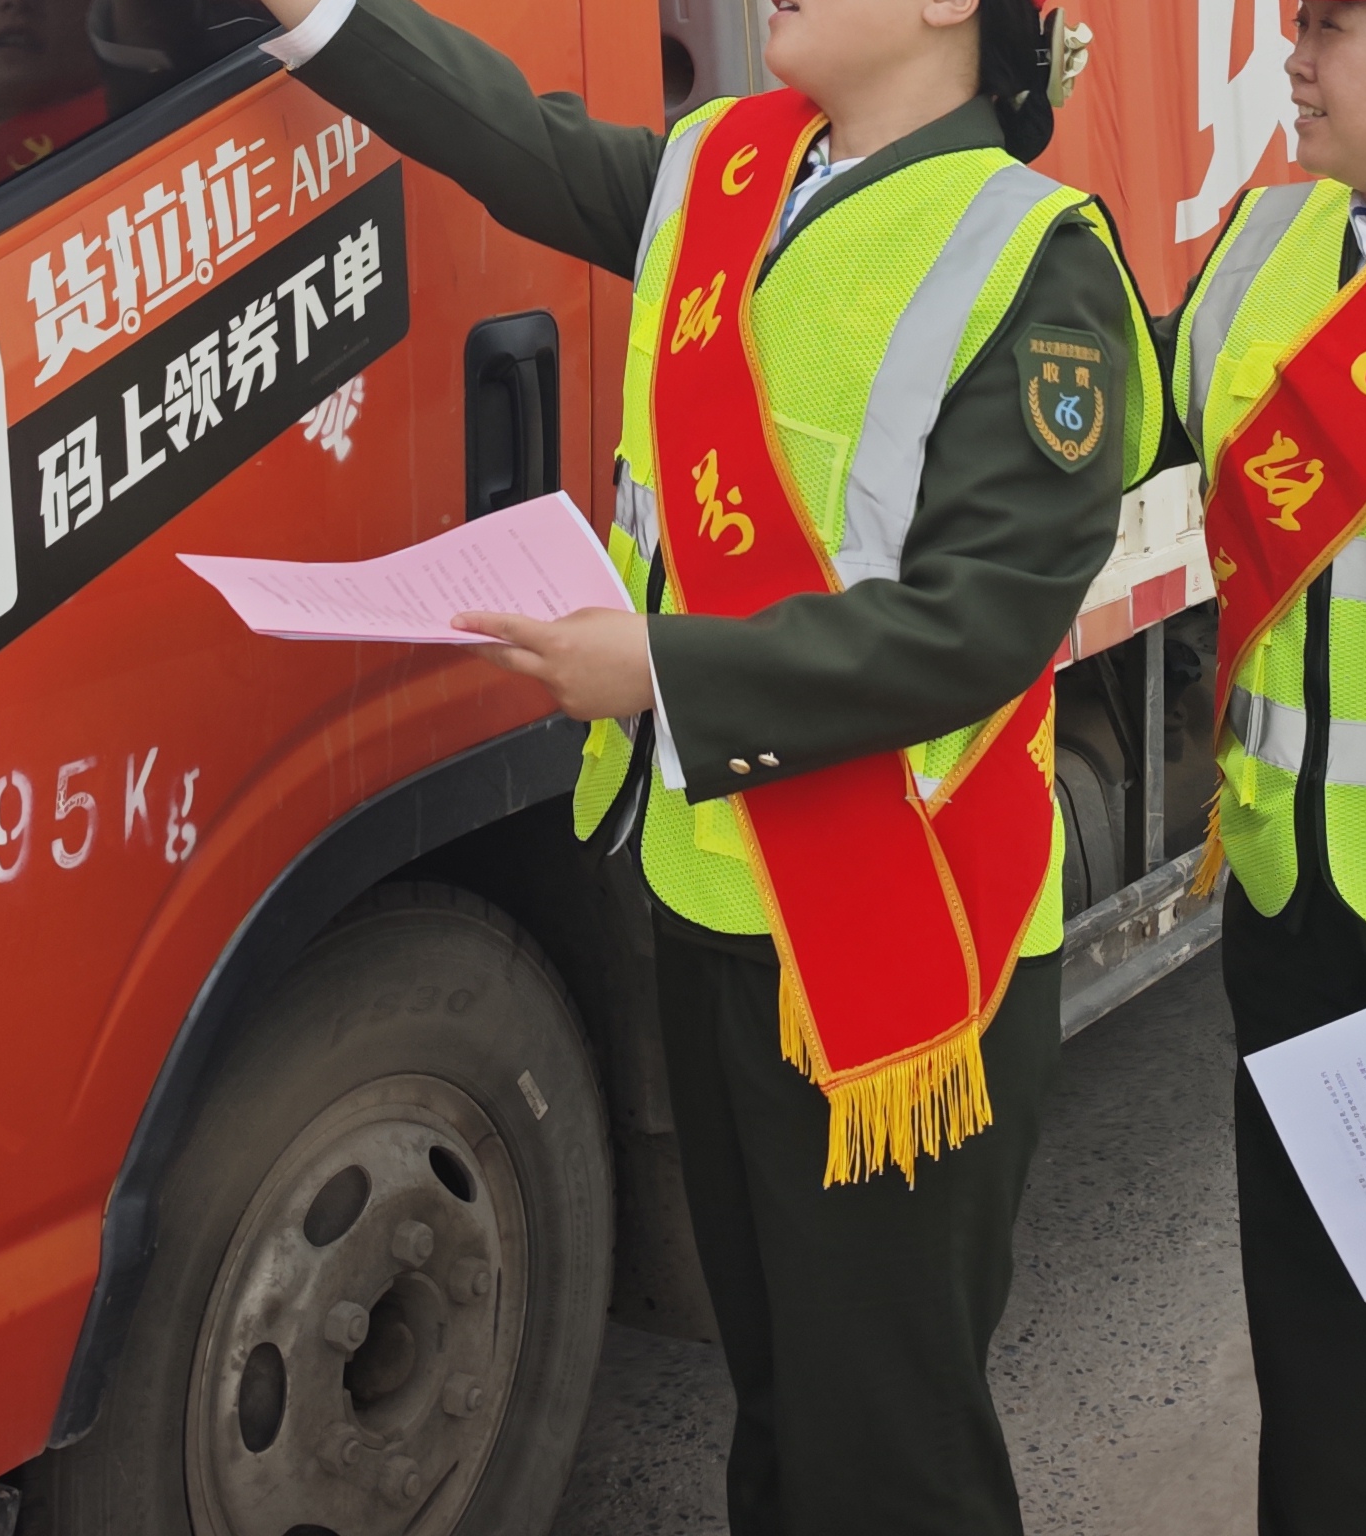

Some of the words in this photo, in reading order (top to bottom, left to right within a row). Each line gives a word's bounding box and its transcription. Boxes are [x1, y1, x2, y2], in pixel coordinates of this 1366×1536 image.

[27, 138, 257, 388] 货拉拉
[289, 114, 370, 217] APP
[38, 219, 382, 549] 码上领券下单
